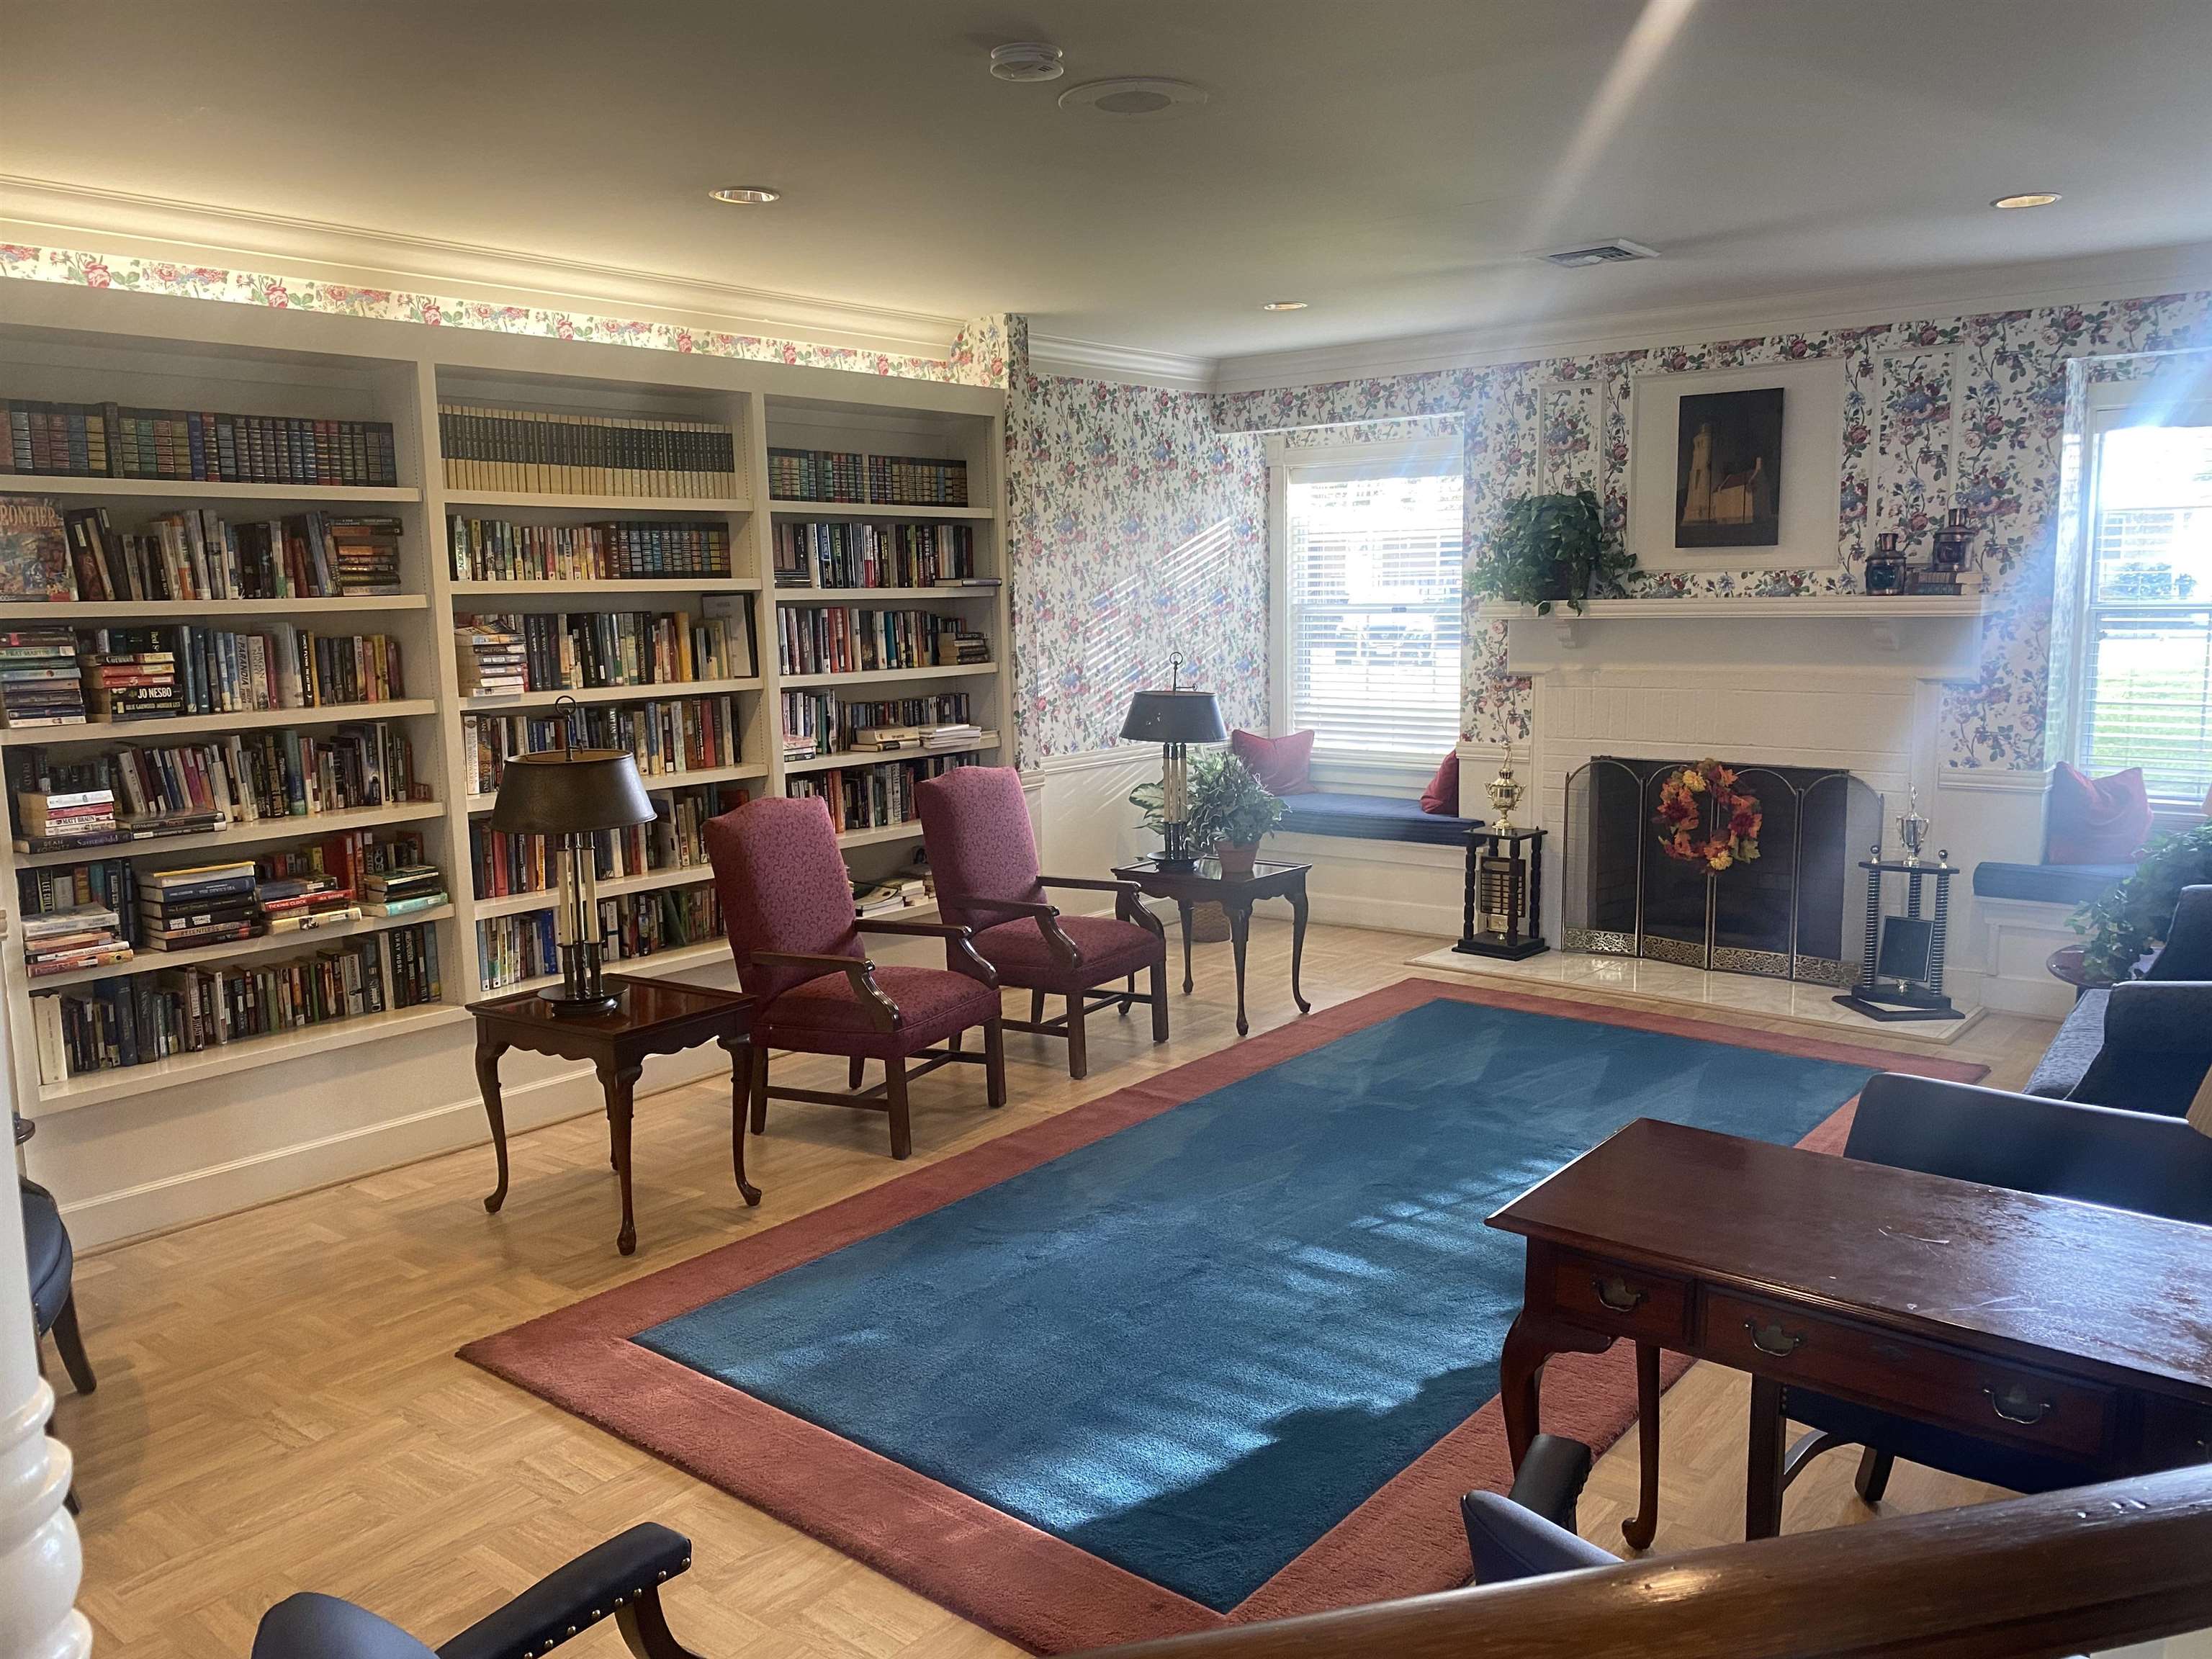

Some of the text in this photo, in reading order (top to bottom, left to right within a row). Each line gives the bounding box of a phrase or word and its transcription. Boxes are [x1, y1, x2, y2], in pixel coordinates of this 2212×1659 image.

[138, 688, 147, 698] JO
[42, 881, 53, 912] LEE CHILD
[181, 925, 220, 935] RELENTLESS
[193, 1019, 202, 1035] JIHAD
